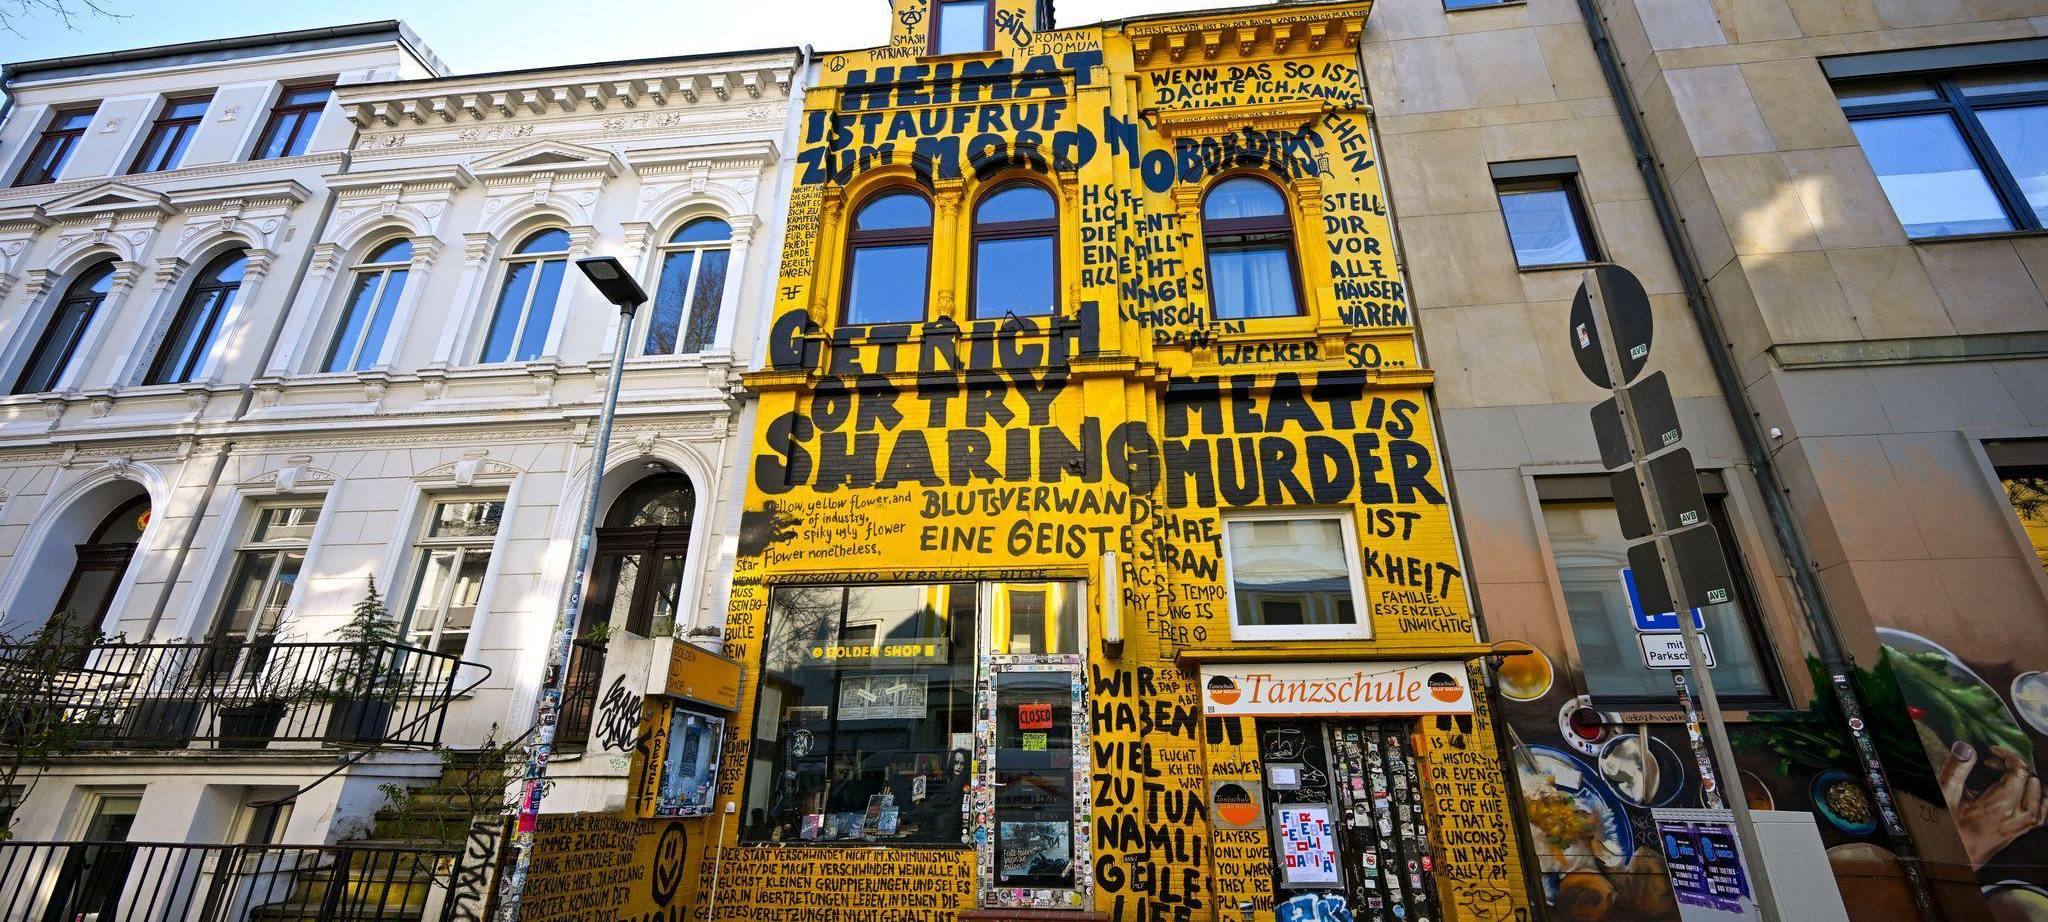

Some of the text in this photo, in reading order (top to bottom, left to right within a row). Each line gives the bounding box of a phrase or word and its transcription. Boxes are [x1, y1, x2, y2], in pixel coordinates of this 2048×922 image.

[1276, 15, 1297, 24] UND
[892, 34, 926, 47] SMASH
[1035, 31, 1091, 43] ROMANI
[867, 46, 926, 62] PATRIARCHY
[1011, 41, 1099, 57] ITE DOMUM
[840, 50, 1104, 110] HEIMAT
[1151, 67, 1218, 87] WENN
[1228, 63, 1270, 82] DAS
[1284, 61, 1315, 79] SO
[1155, 80, 1246, 104] DACHTE
[806, 100, 1067, 151] IST AUFRUF
[797, 122, 1098, 188] ZUM MORD
[1175, 125, 1327, 186] BORDERS
[788, 209, 805, 217] SICH
[1323, 192, 1386, 217] STELL
[786, 223, 820, 232] SONDERN
[1325, 216, 1369, 236] DIR
[782, 248, 809, 259] GENDE
[1328, 237, 1381, 256] VOR
[1331, 258, 1388, 280] ALLE
[1334, 279, 1406, 302] HÄUSER
[1337, 301, 1408, 328] WÄREN
[769, 307, 912, 372] GET
[1217, 340, 1318, 366] WECKER
[811, 364, 1070, 432] OR TRY
[1164, 370, 1420, 440] MEAT IS
[1663, 432, 1678, 443] AVB
[755, 410, 1161, 495] SHARING
[1162, 431, 1448, 508] MURDER
[808, 500, 847, 516] yellow
[892, 491, 912, 504] and
[808, 512, 820, 529] of
[1366, 507, 1422, 541] IST
[1681, 511, 1697, 522] AVB
[803, 527, 833, 544] spiky
[836, 528, 858, 543] ugly
[865, 522, 907, 541] flower
[919, 525, 994, 552] EINE
[736, 560, 759, 573] Star
[763, 548, 805, 568] Flower
[767, 571, 879, 583] DEUTSCHLAND
[1363, 547, 1461, 599] KHEIT
[730, 588, 754, 598] MUSS
[1708, 589, 1727, 601] AVB
[1195, 603, 1213, 619] IS
[1375, 603, 1458, 617] ESSENZIELL
[724, 625, 755, 642] BULLE
[1399, 617, 1472, 634] UNWICHTIG
[826, 645, 921, 658] GOLDEN SHOP
[1667, 640, 1684, 649] mit
[673, 646, 697, 663] GOLDEN
[668, 680, 685, 690] SHOP
[1093, 664, 1158, 698] WIR
[1246, 671, 1422, 704] Tanzschule
[1020, 709, 1051, 724] CLOSED
[1092, 700, 1198, 740] HABEN
[1430, 737, 1443, 749] IS
[729, 754, 745, 767] THE
[1094, 740, 1162, 778] VIEL
[1159, 749, 1196, 762] FLUCHT
[1169, 763, 1183, 776] ICH
[1212, 760, 1261, 776] ANSWER
[1433, 769, 1485, 781] OR EVEN
[1093, 773, 1136, 807] ZU
[1435, 783, 1478, 796] ON THE
[1460, 800, 1475, 812] OF
[1452, 814, 1484, 828] THAT
[541, 834, 571, 852] IMMER
[1214, 831, 1261, 845] PLAYERS
[566, 852, 632, 871] KONTROLLE UND
[721, 850, 740, 862] DER
[743, 849, 771, 861] STAAT
[774, 849, 844, 861] VERSCHWINDET
[846, 850, 870, 861] NICHT
[1215, 847, 1270, 860] ONLY LOVE
[1453, 848, 1468, 863] IN
[596, 864, 646, 887] JAHRELANG
[781, 863, 815, 875] MACHT
[819, 863, 895, 876] VERSCHWINDEN
[898, 863, 926, 876] WENN
[957, 866, 971, 878] IN
[1216, 862, 1272, 877] YOU WHEN
[766, 876, 812, 889] KLEINEN
[912, 876, 933, 890] UND
[956, 880, 971, 893] ES
[568, 886, 631, 912] KONSUM DER
[755, 888, 849, 907] ÜBERTRETUNGEN
[901, 893, 938, 907] DENEN
[942, 892, 959, 907] DIE
[843, 906, 956, 922] NICHT GEWALT IST
